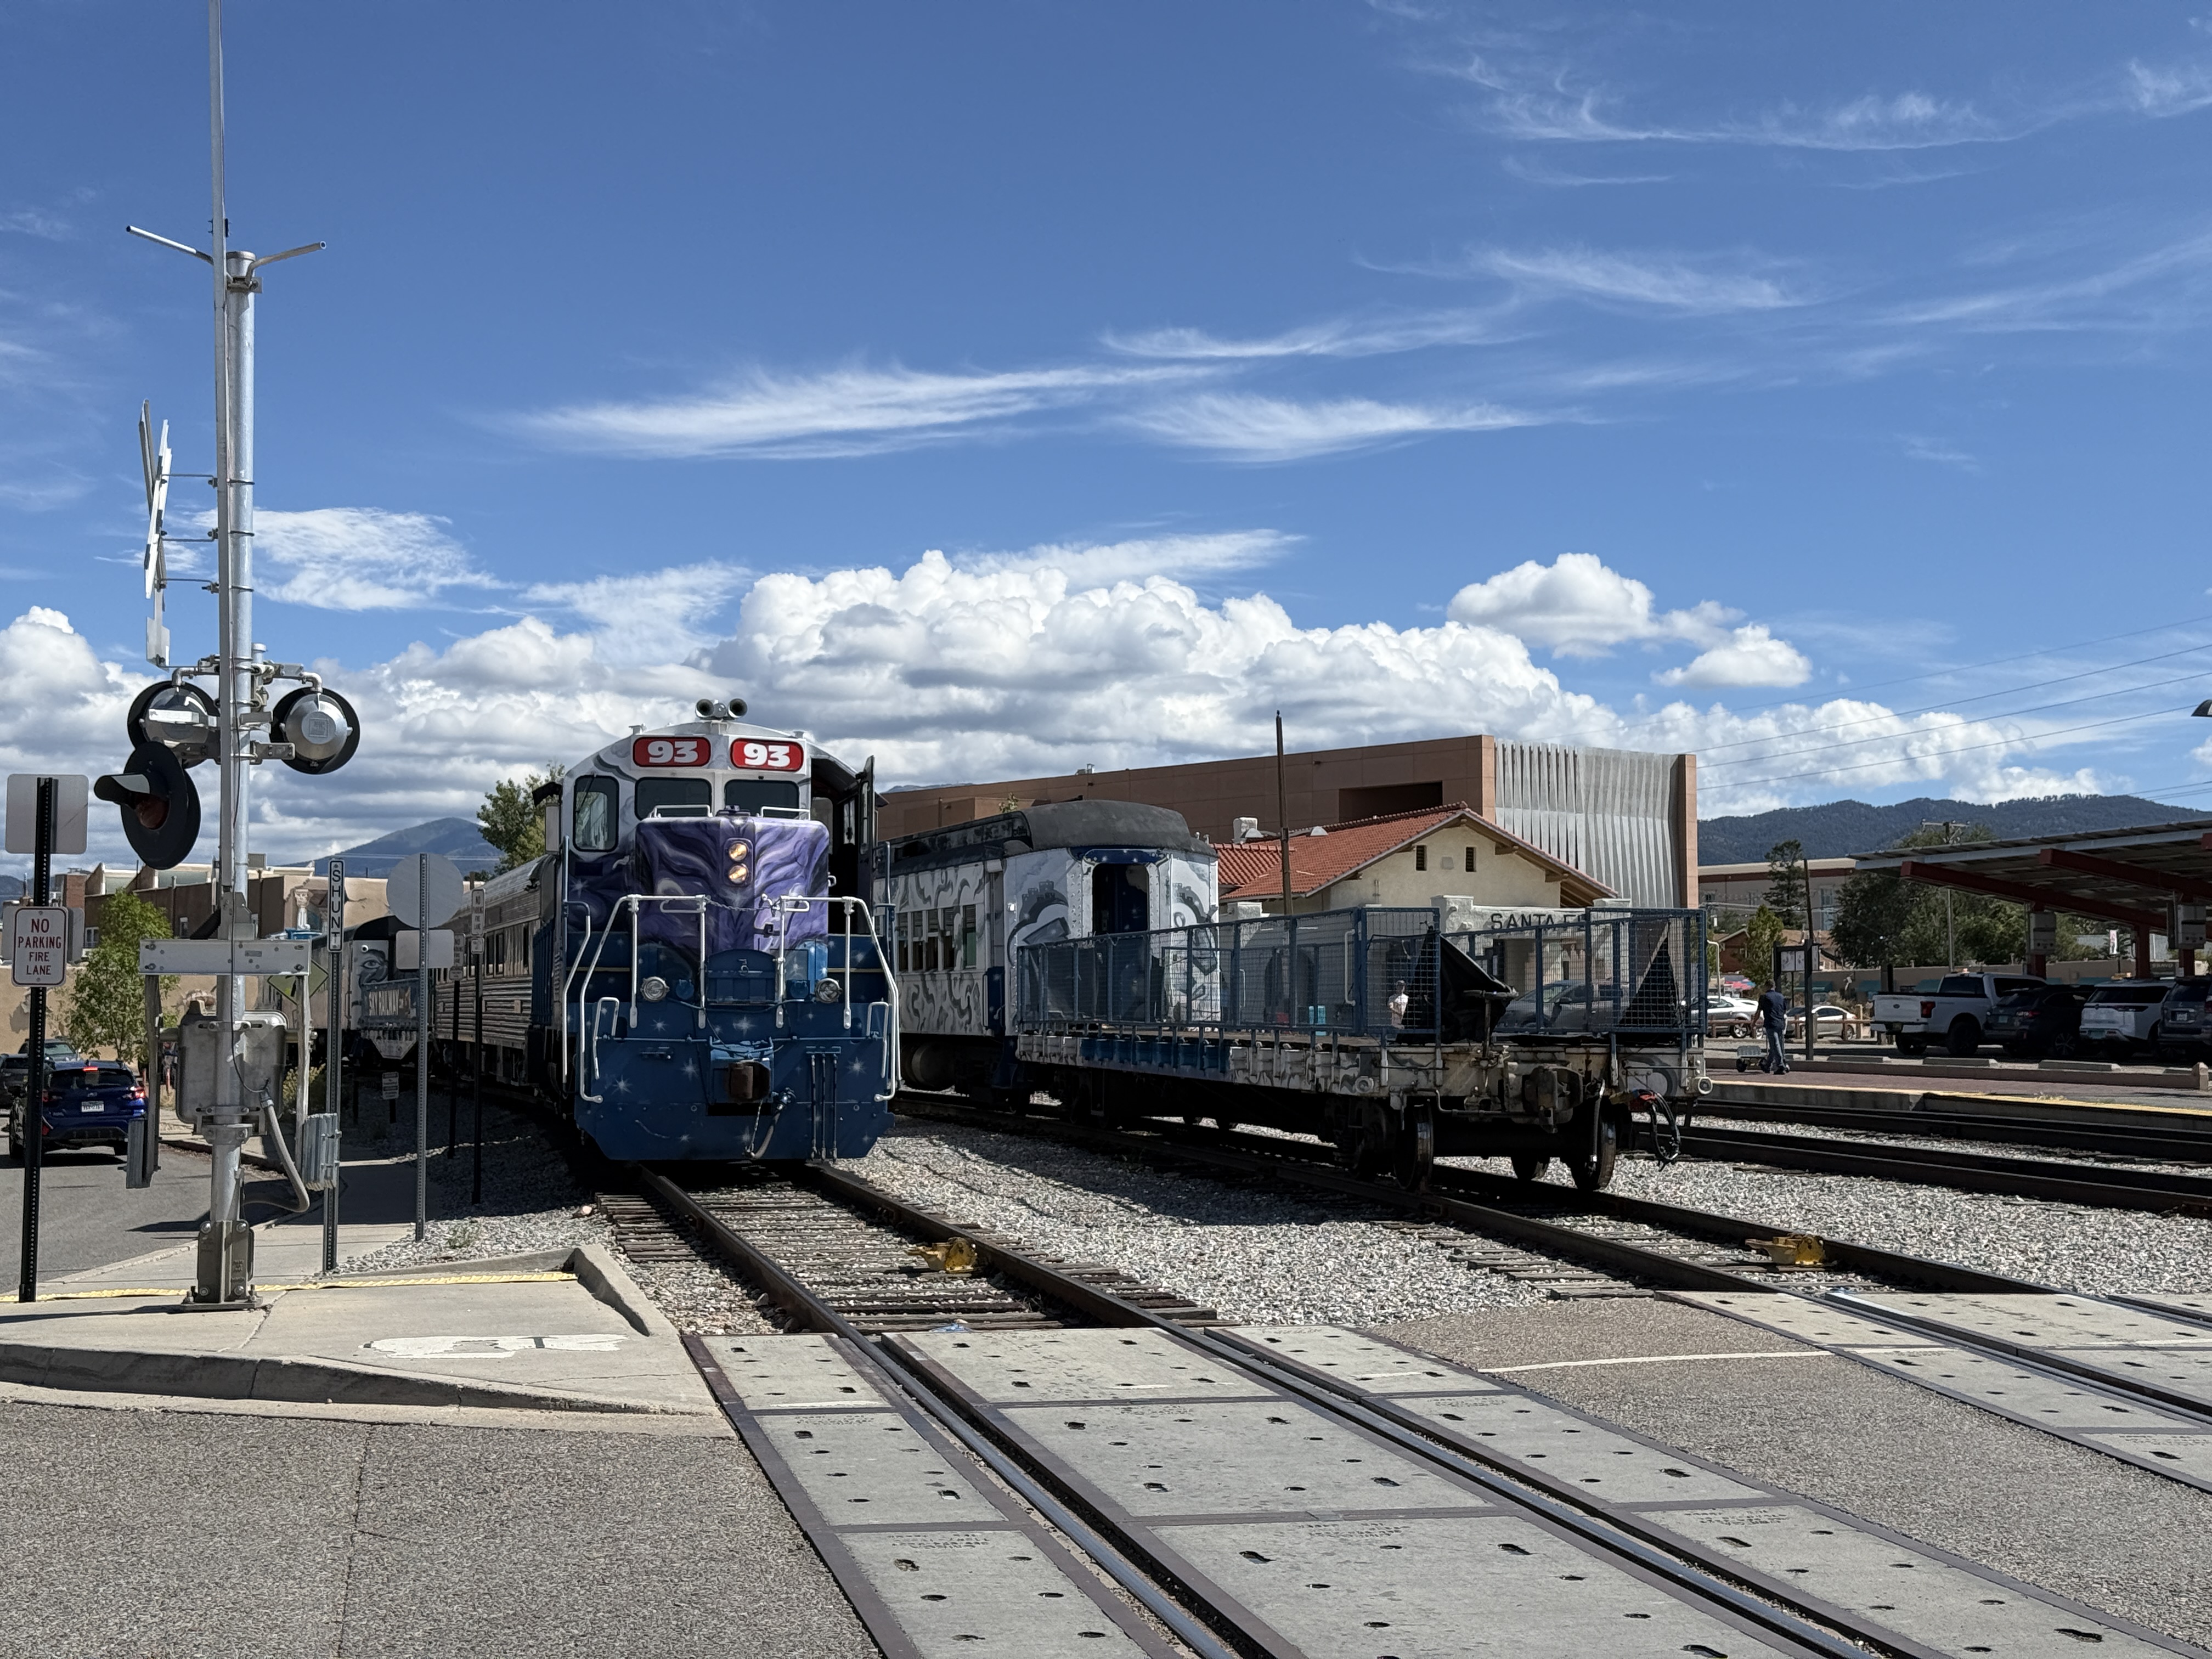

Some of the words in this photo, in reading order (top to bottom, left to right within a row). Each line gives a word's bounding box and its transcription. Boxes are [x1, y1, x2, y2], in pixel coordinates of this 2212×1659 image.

[648, 741, 698, 763] 93
[743, 743, 791, 767] 93
[331, 870, 341, 941] SHUNT
[31, 918, 50, 933] NO
[1491, 913, 1554, 930] SANTA
[18, 936, 62, 949] PARKING
[29, 951, 50, 962] FIRE
[26, 965, 52, 975] LANE
